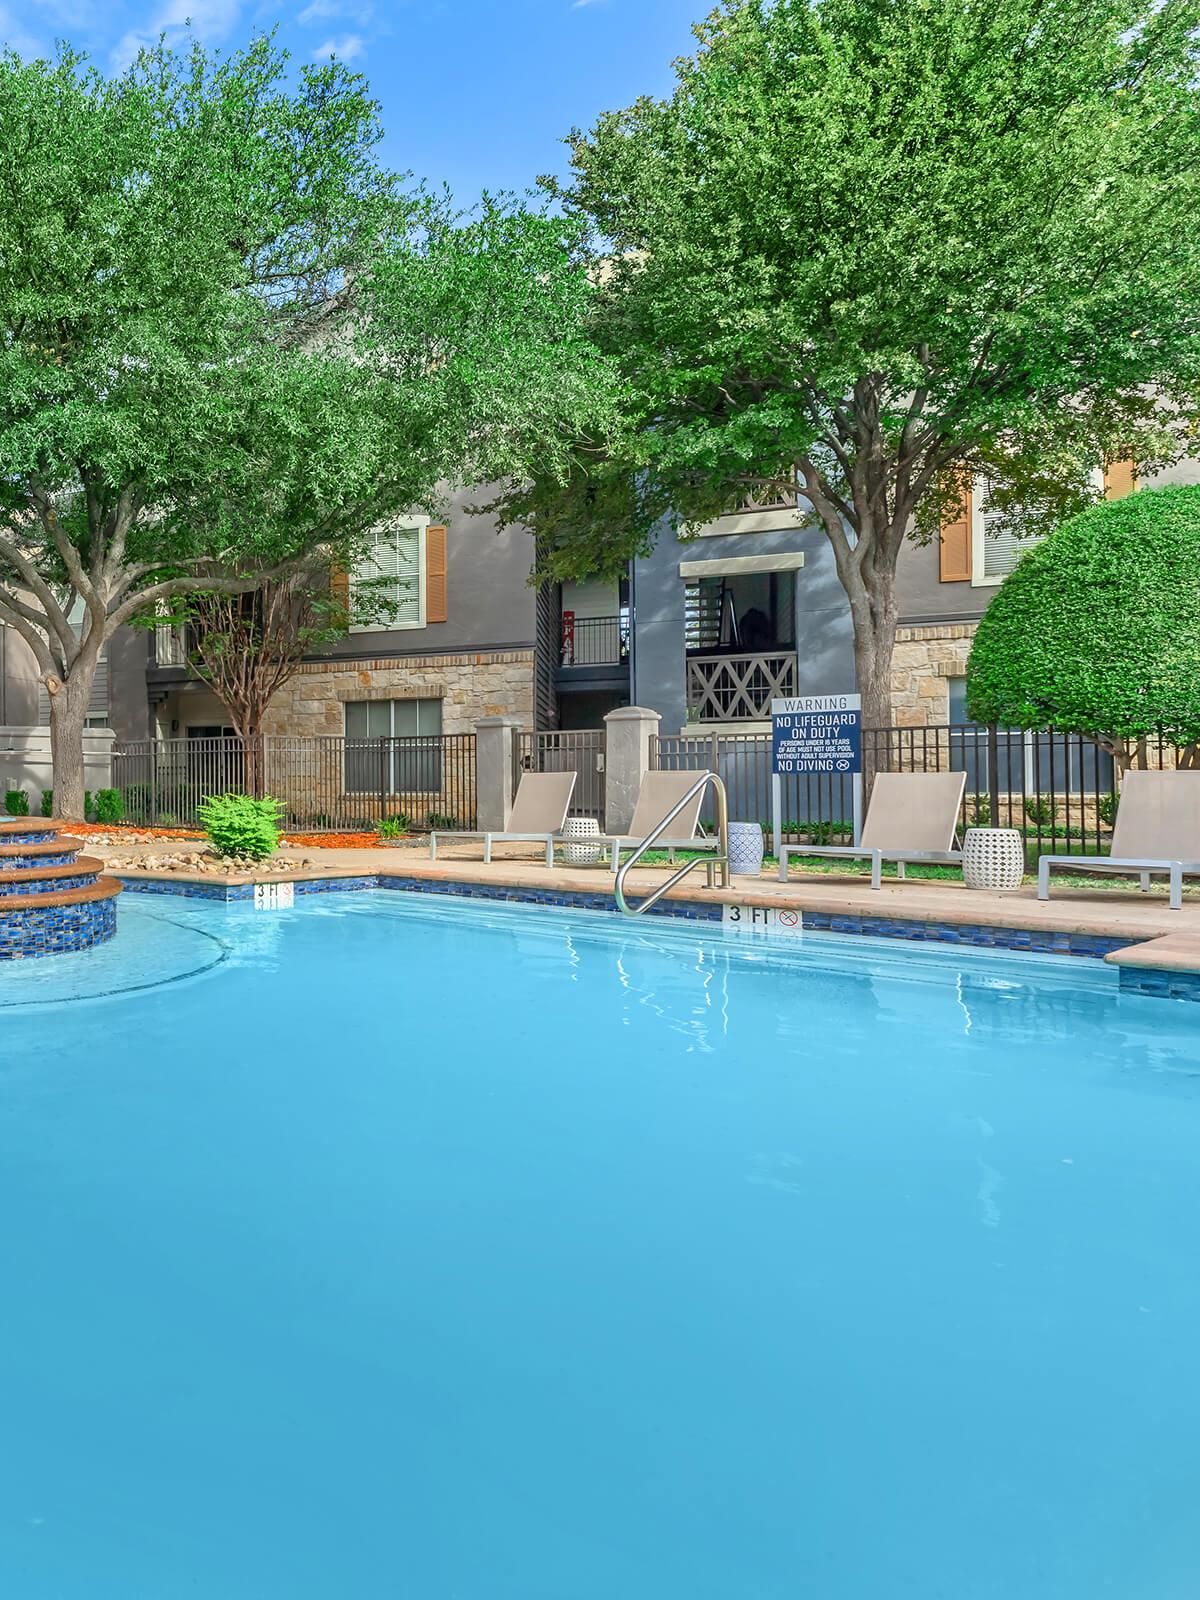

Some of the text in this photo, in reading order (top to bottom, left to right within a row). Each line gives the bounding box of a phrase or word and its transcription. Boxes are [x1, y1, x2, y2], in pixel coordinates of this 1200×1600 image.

[784, 697, 847, 712] WARNING
[776, 713, 856, 728] NO LIFEGUARD
[791, 726, 840, 740] ON DUTY
[837, 744, 853, 752] POOL
[776, 752, 800, 760] WITHOUT
[818, 751, 855, 759] SUPERVISION
[777, 759, 834, 771] NO DIVING
[258, 884, 264, 897] 3
[730, 906, 770, 924] 3 FT
